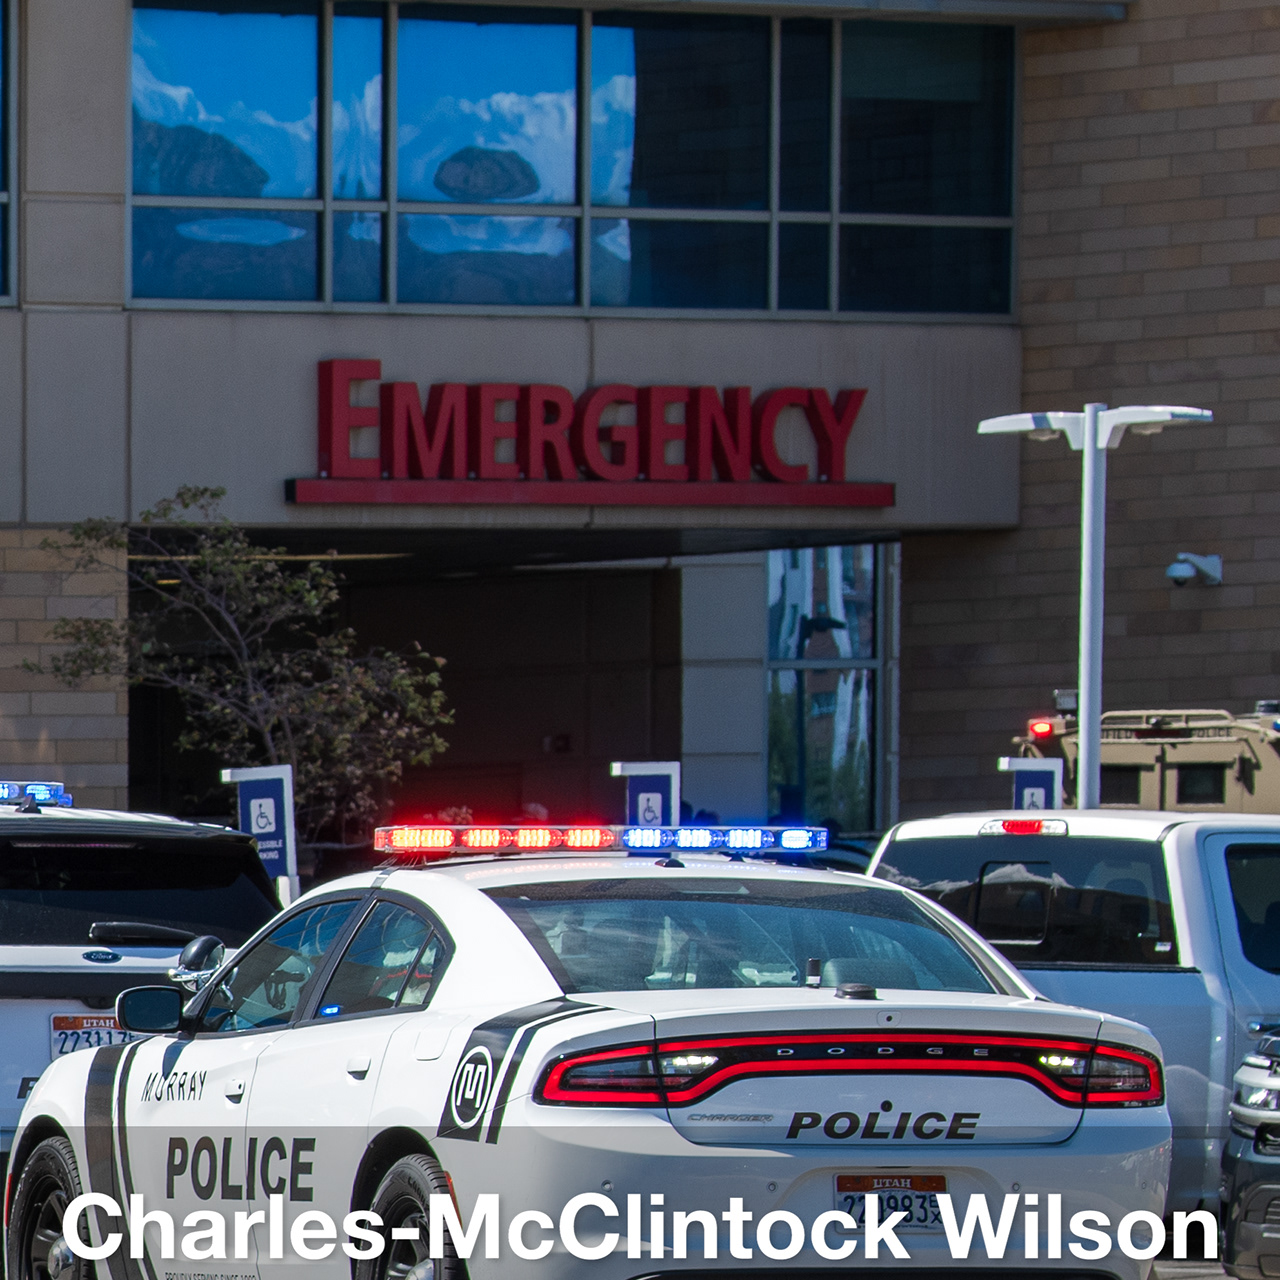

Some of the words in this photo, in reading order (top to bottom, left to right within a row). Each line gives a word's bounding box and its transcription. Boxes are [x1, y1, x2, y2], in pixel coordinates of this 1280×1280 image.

[317, 358, 869, 482] EMERGENCY
[83, 1019, 115, 1028] UTAH
[777, 1046, 990, 1057] DODGE
[140, 1070, 208, 1102] MURRAY
[785, 1111, 981, 1140] POLICE
[166, 1135, 316, 1202] POLICE
[872, 1178, 912, 1188] UTAH
